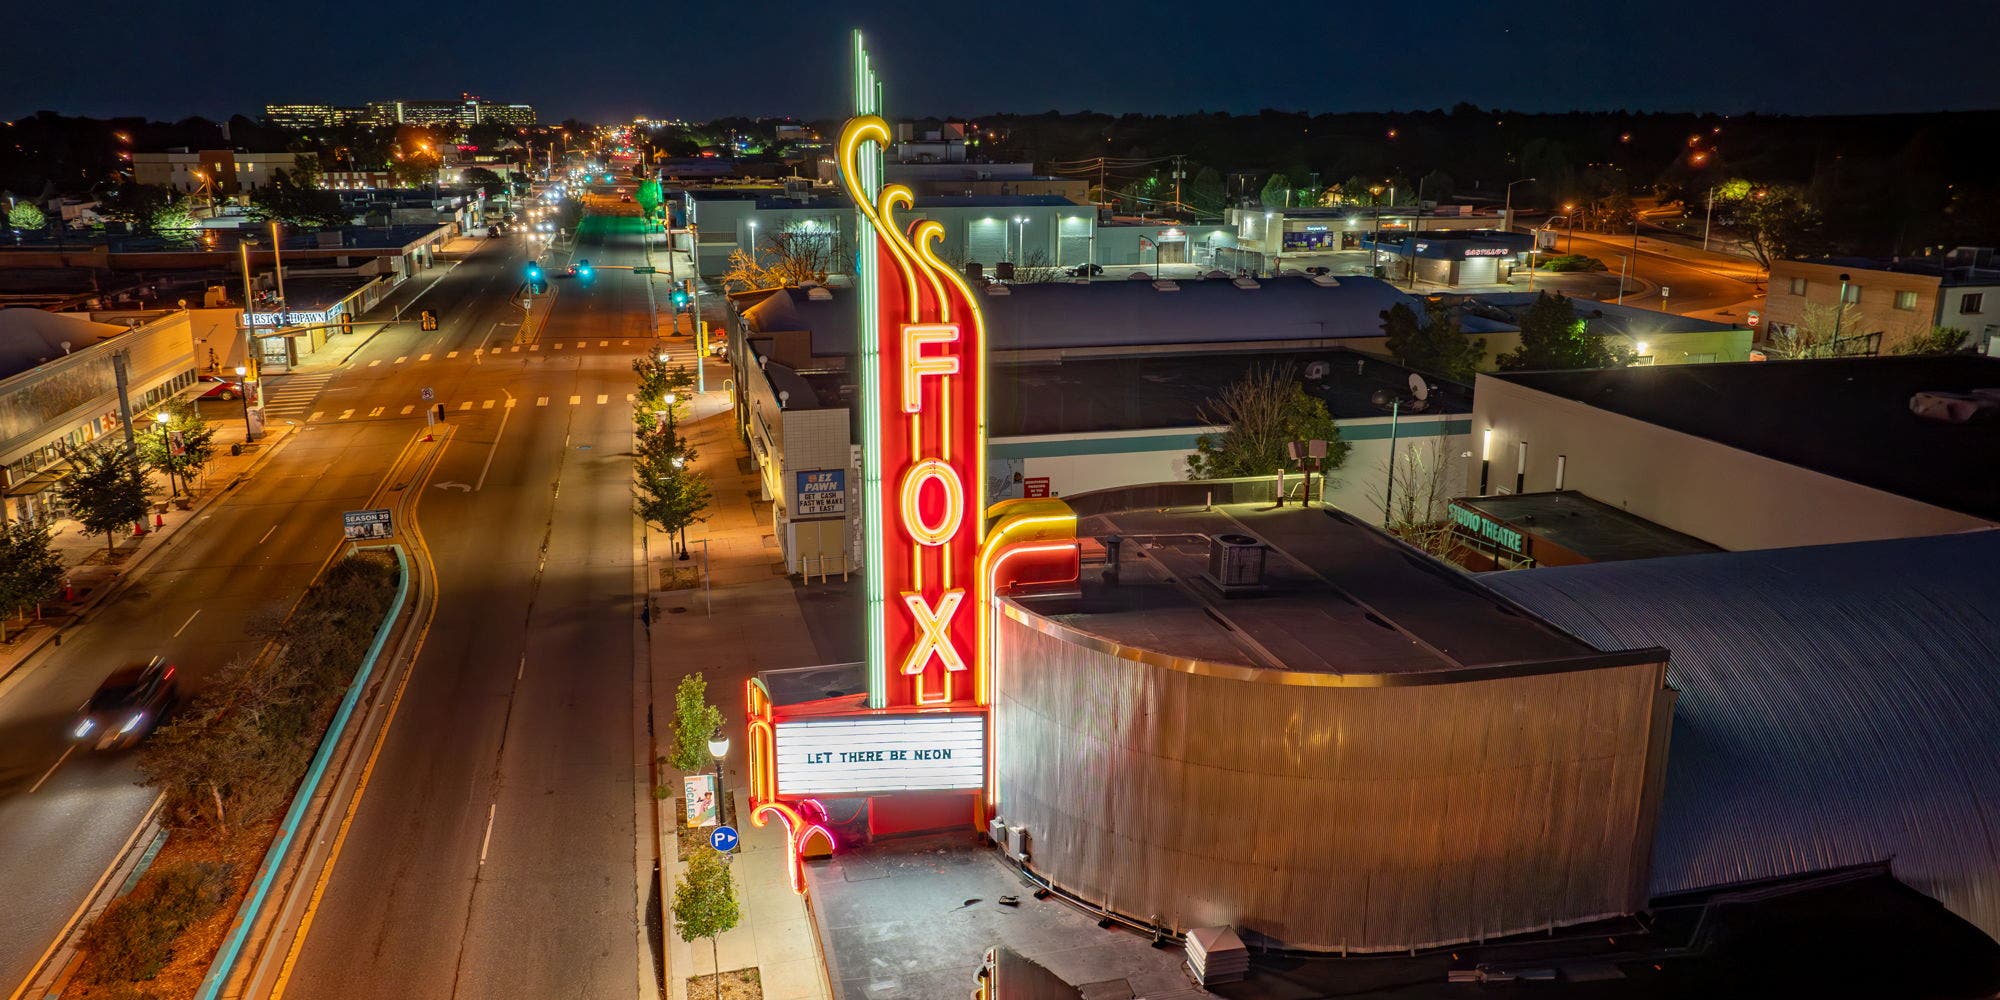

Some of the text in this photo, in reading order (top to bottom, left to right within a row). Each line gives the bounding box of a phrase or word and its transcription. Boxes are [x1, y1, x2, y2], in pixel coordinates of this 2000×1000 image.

[244, 314, 272, 325] FRST
[818, 473, 832, 482] EZ
[804, 482, 837, 491] PAWN
[900, 323, 967, 675] FOX
[1448, 503, 1522, 552] STUDIO THEATRE
[807, 749, 952, 764] LET THERE BE NEON
[686, 782, 696, 819] LOCALES
[714, 832, 726, 847] P
